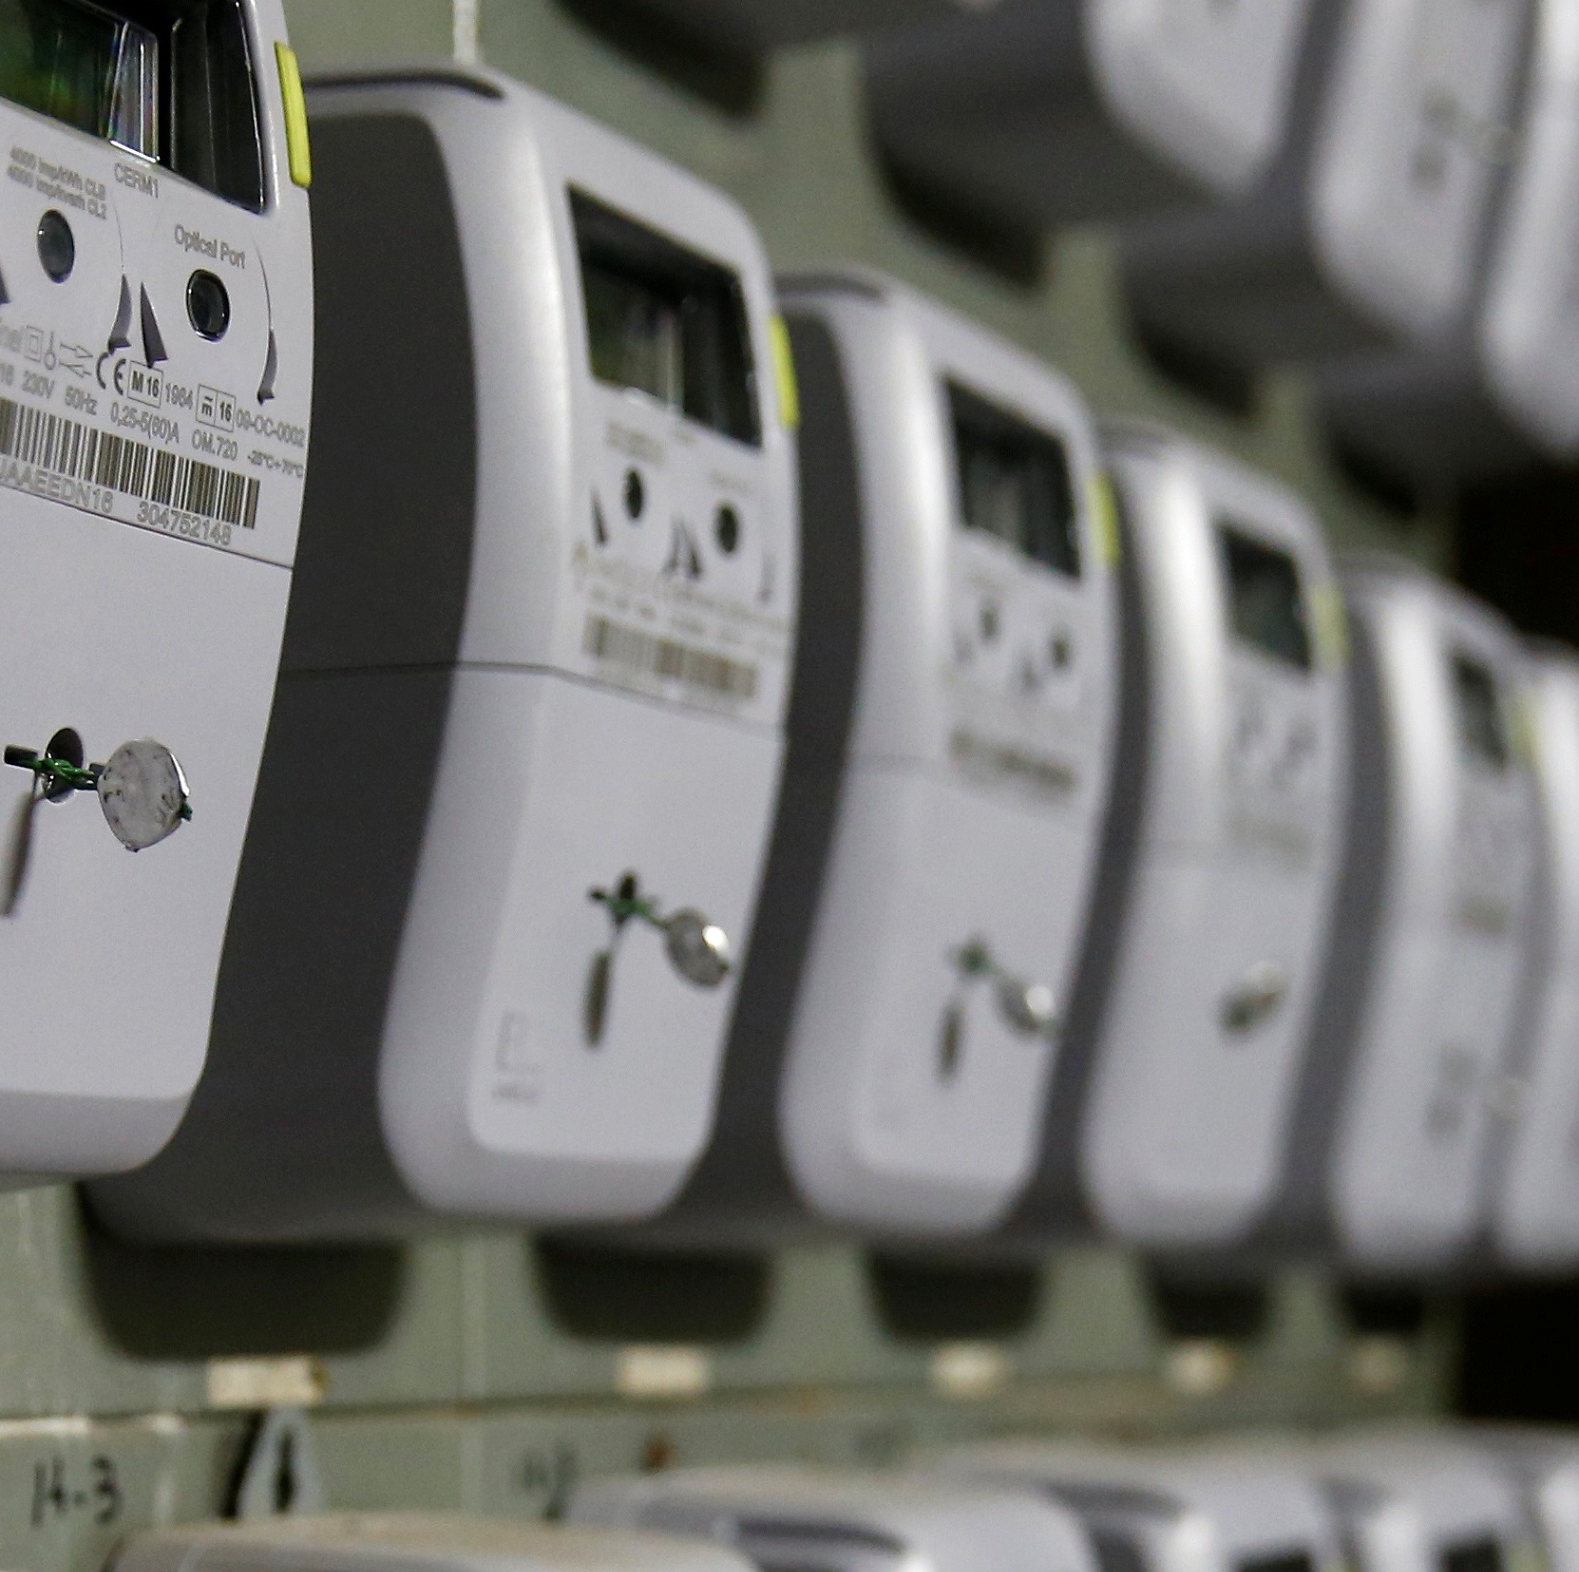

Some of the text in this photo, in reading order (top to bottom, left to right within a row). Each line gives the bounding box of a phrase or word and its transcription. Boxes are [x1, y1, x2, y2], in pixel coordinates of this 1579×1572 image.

[114, 162, 159, 199] CERM1
[174, 224, 246, 270] Optical Port
[64, 384, 98, 416] 50Hz
